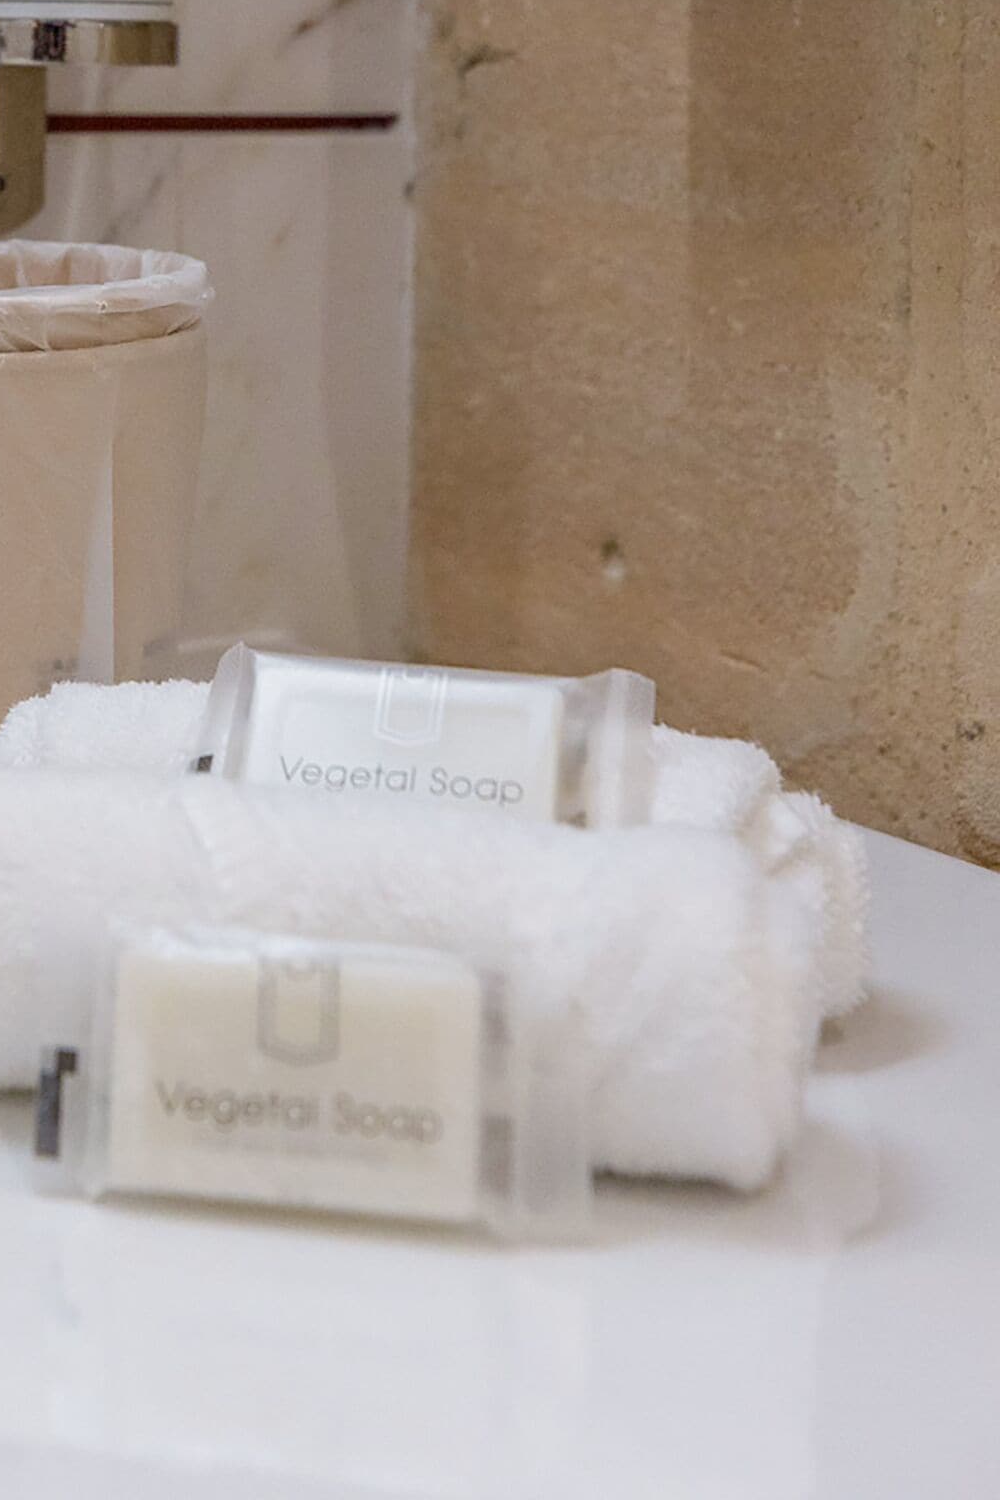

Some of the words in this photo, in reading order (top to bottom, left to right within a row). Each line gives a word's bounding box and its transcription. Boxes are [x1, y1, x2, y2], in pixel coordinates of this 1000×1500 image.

[279, 754, 417, 794] Vegetal
[428, 766, 526, 807] Soap
[154, 1078, 321, 1133] Vegetal
[332, 1091, 445, 1146] Soap
